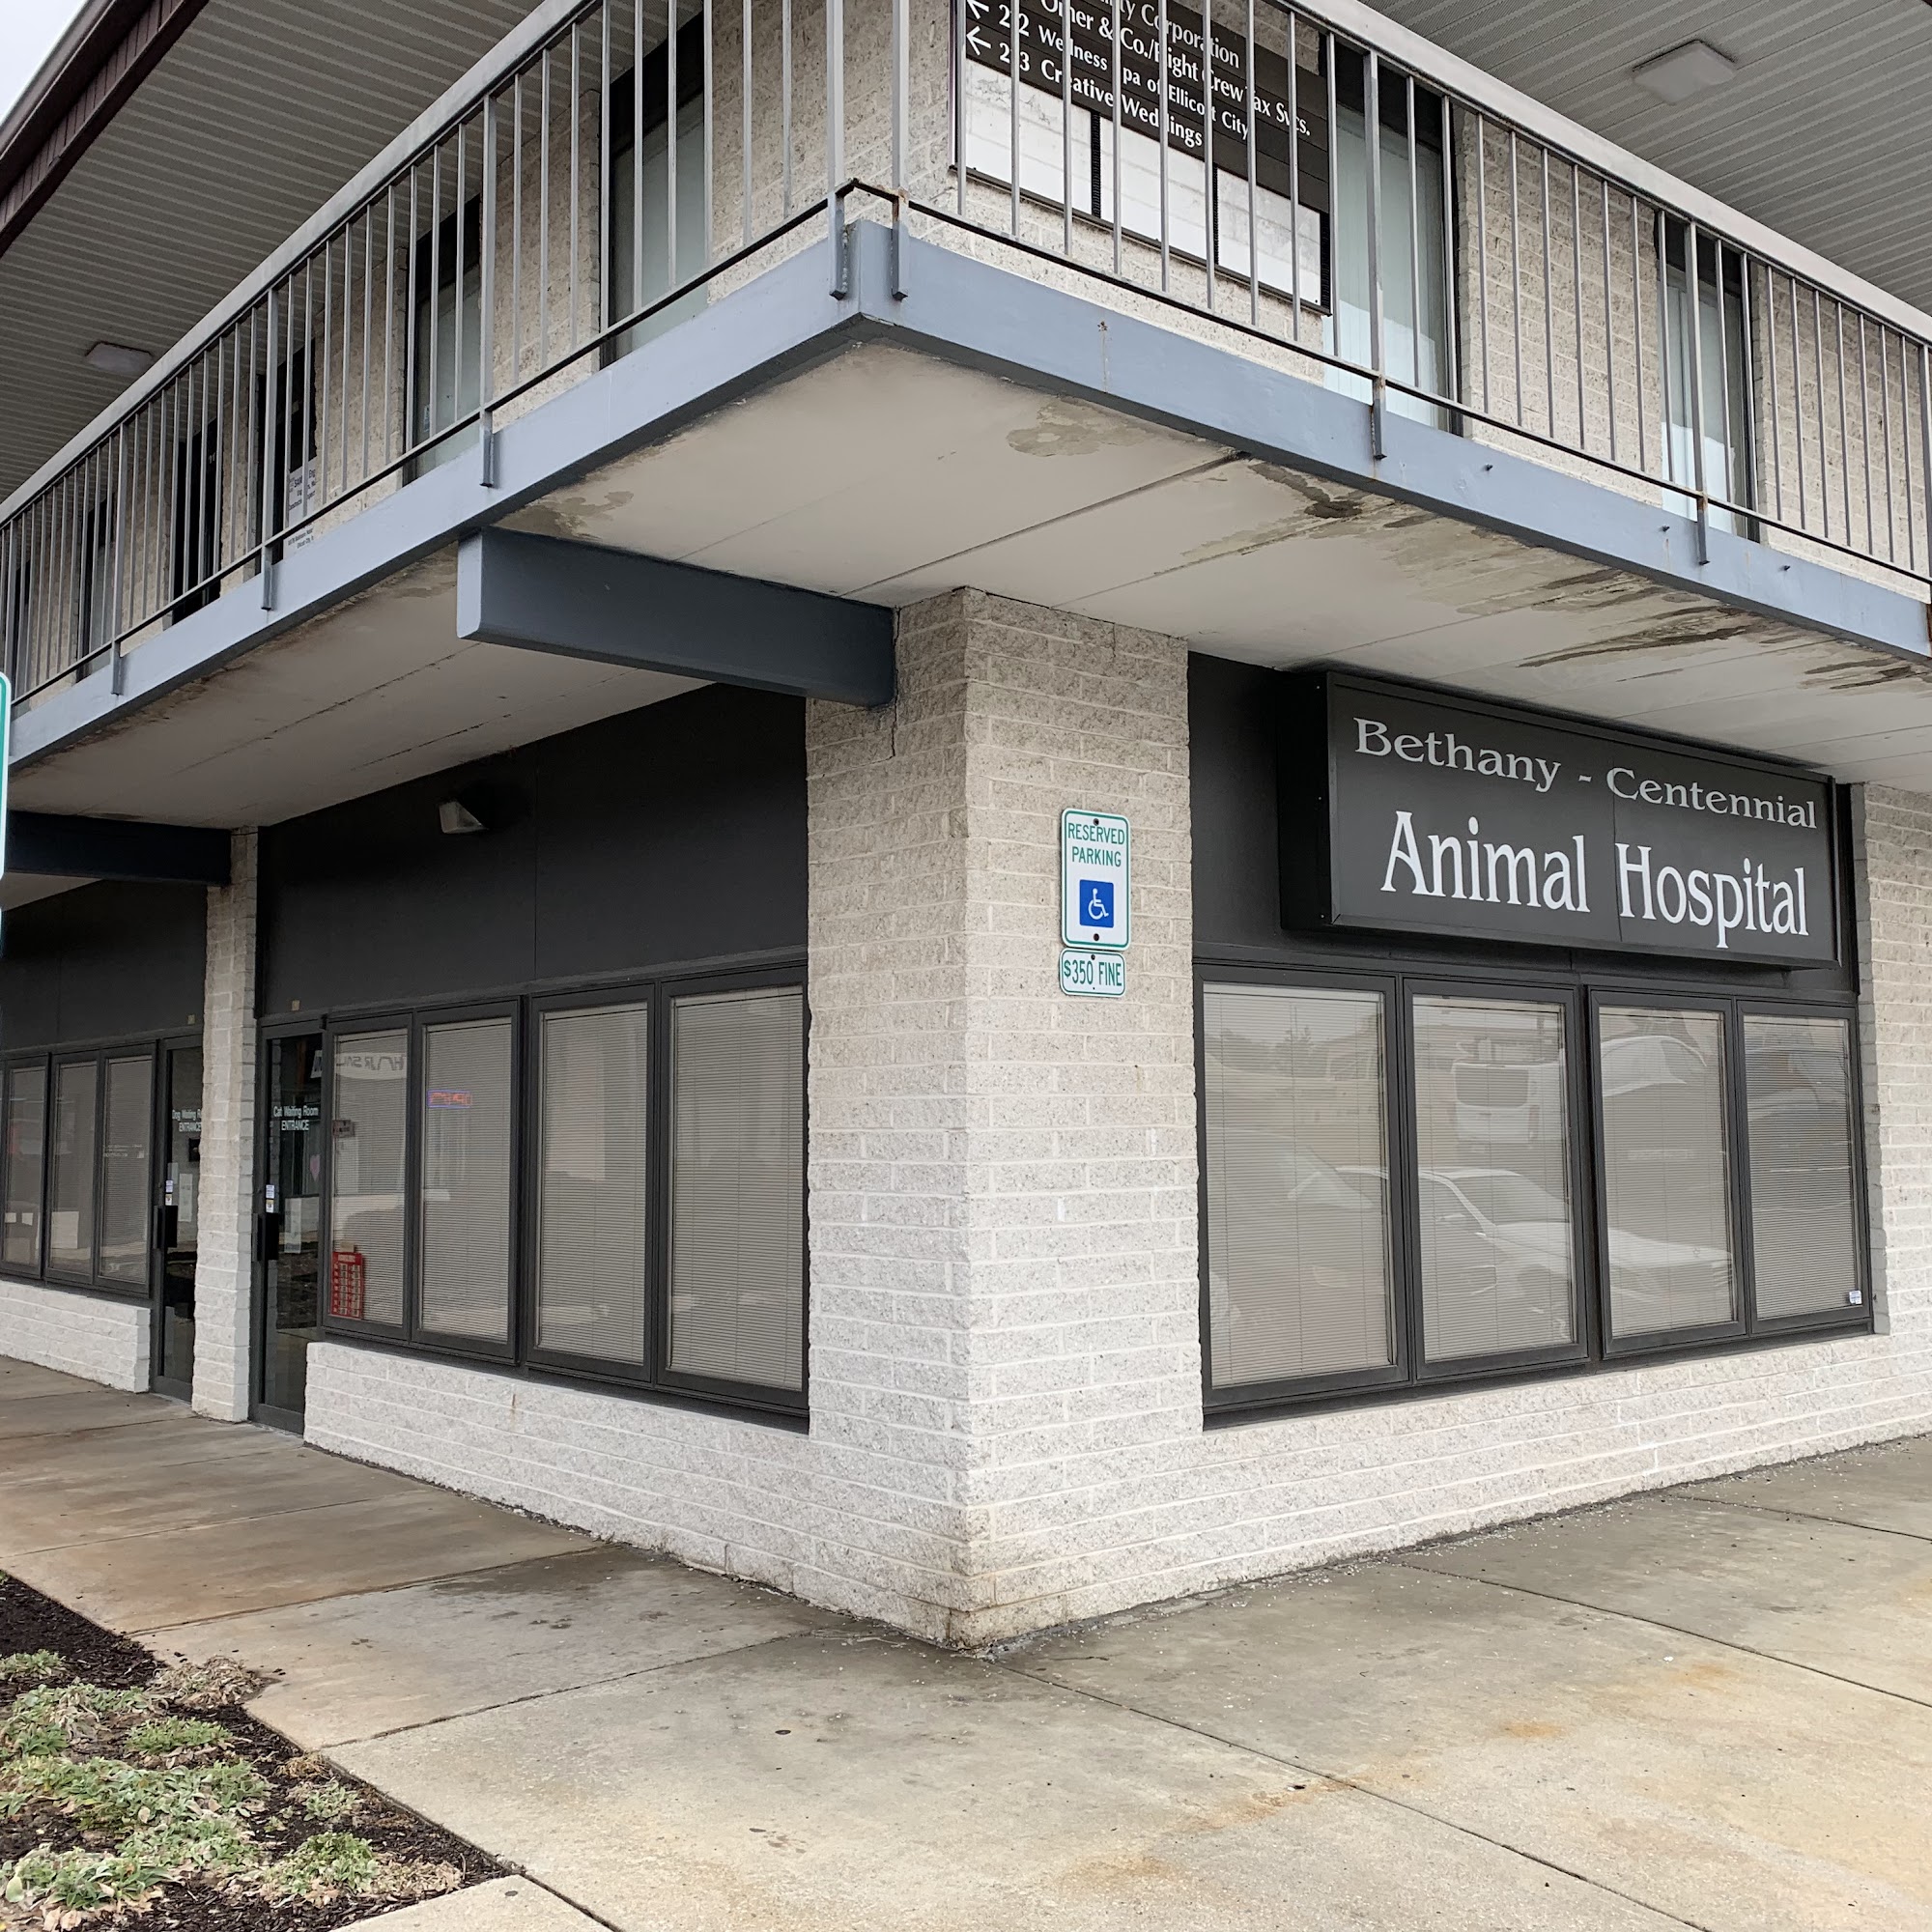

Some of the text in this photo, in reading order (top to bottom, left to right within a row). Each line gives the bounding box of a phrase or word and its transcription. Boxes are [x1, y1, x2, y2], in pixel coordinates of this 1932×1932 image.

[998, 4, 1030, 38] 22
[1037, 24, 1109, 72] Welness
[1122, 67, 1141, 87] pa
[1168, 83, 1217, 123] Ellicot
[1221, 110, 1249, 141] City
[999, 42, 1031, 72] 23
[1039, 59, 1114, 107] Crative
[1097, 16, 1114, 41] &
[1245, 85, 1270, 118] ax
[1353, 717, 1817, 829] Bethany - Centennial
[1067, 822, 1125, 845] RESERVED
[1071, 845, 1122, 867] PARKING
[1379, 810, 1810, 949] Animal Hospital
[1064, 959, 1122, 986] $350 FINE
[273, 1105, 319, 1119] Cat Waiting Room
[281, 1120, 310, 1131] ENTRANCE
